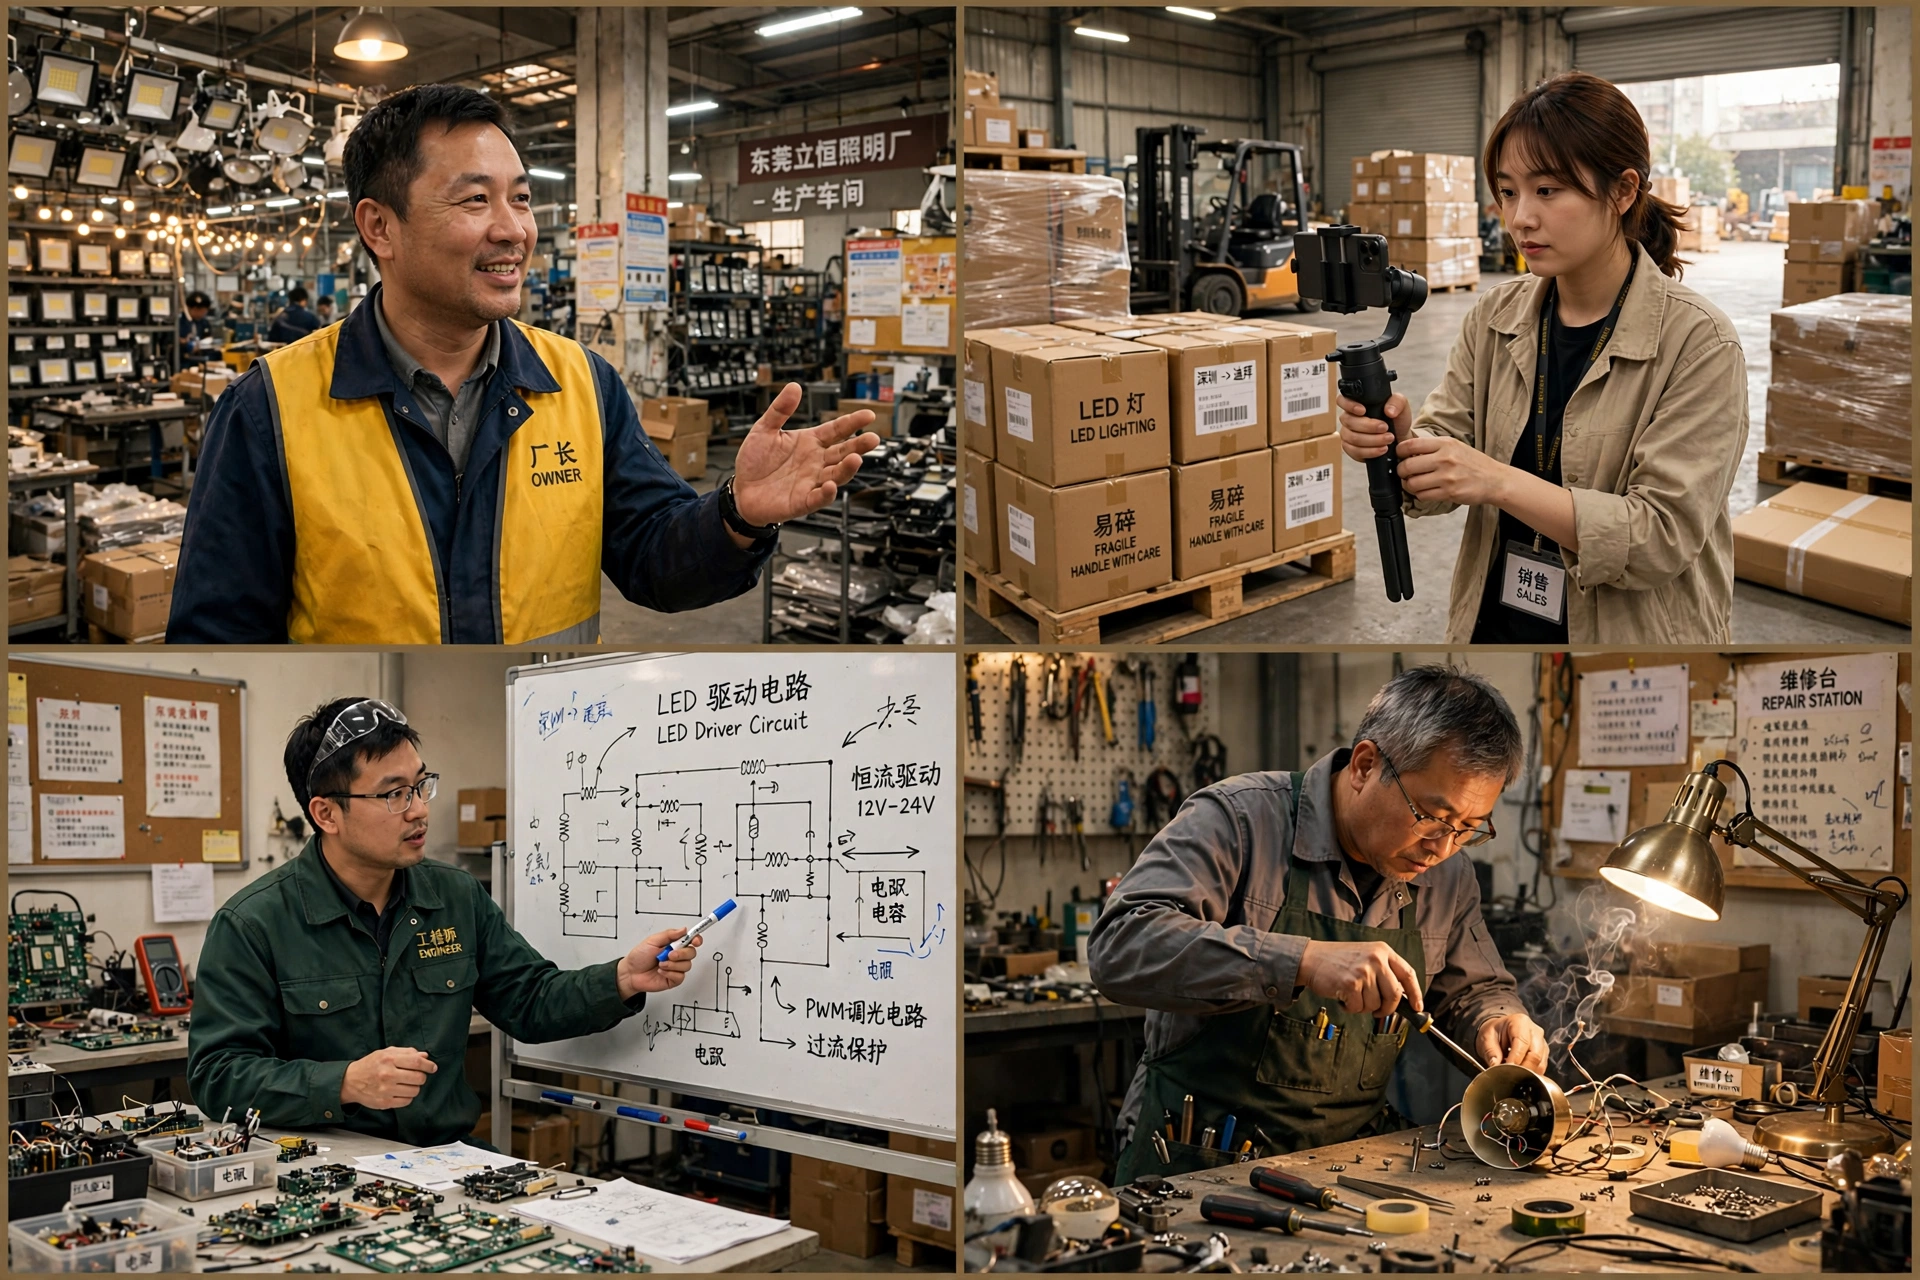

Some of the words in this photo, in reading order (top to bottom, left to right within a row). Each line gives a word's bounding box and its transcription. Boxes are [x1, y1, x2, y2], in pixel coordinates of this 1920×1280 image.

[750, 130, 912, 175] 东莞立恒照明厂
[771, 179, 864, 213] 生产车间
[1079, 397, 1119, 420] LED
[1126, 392, 1146, 415] 灯
[1070, 427, 1096, 444] LED
[1099, 418, 1156, 440] LIGHTING
[530, 441, 578, 468] 厂长
[531, 468, 583, 487] OWNER
[1208, 484, 1245, 512] 易碎
[1093, 508, 1136, 538] 易碎
[1209, 510, 1245, 528] FRAGILE
[1094, 536, 1137, 556] FRAGILE
[1189, 530, 1222, 548] HANDLE
[1223, 525, 1244, 540] WITH
[1245, 519, 1265, 534] CARE
[1070, 559, 1110, 578] HANDLE
[1112, 552, 1136, 568] WITH
[1137, 546, 1161, 562] CARE
[1517, 566, 1549, 593] 销售
[1516, 587, 1548, 607] SALES
[1780, 667, 1837, 691] 维修台
[658, 689, 697, 716] LED
[706, 670, 813, 712] 驱动电路
[1762, 694, 1806, 710] REPAIR
[1808, 690, 1863, 708] STATION
[658, 723, 688, 744] LED
[695, 721, 742, 740] Driver
[750, 710, 808, 735] Circuit
[851, 761, 941, 791] 恒流驱动
[858, 795, 935, 817] 12V-24V
[872, 902, 907, 924] 电容
[807, 1033, 888, 1065] 过流保护
